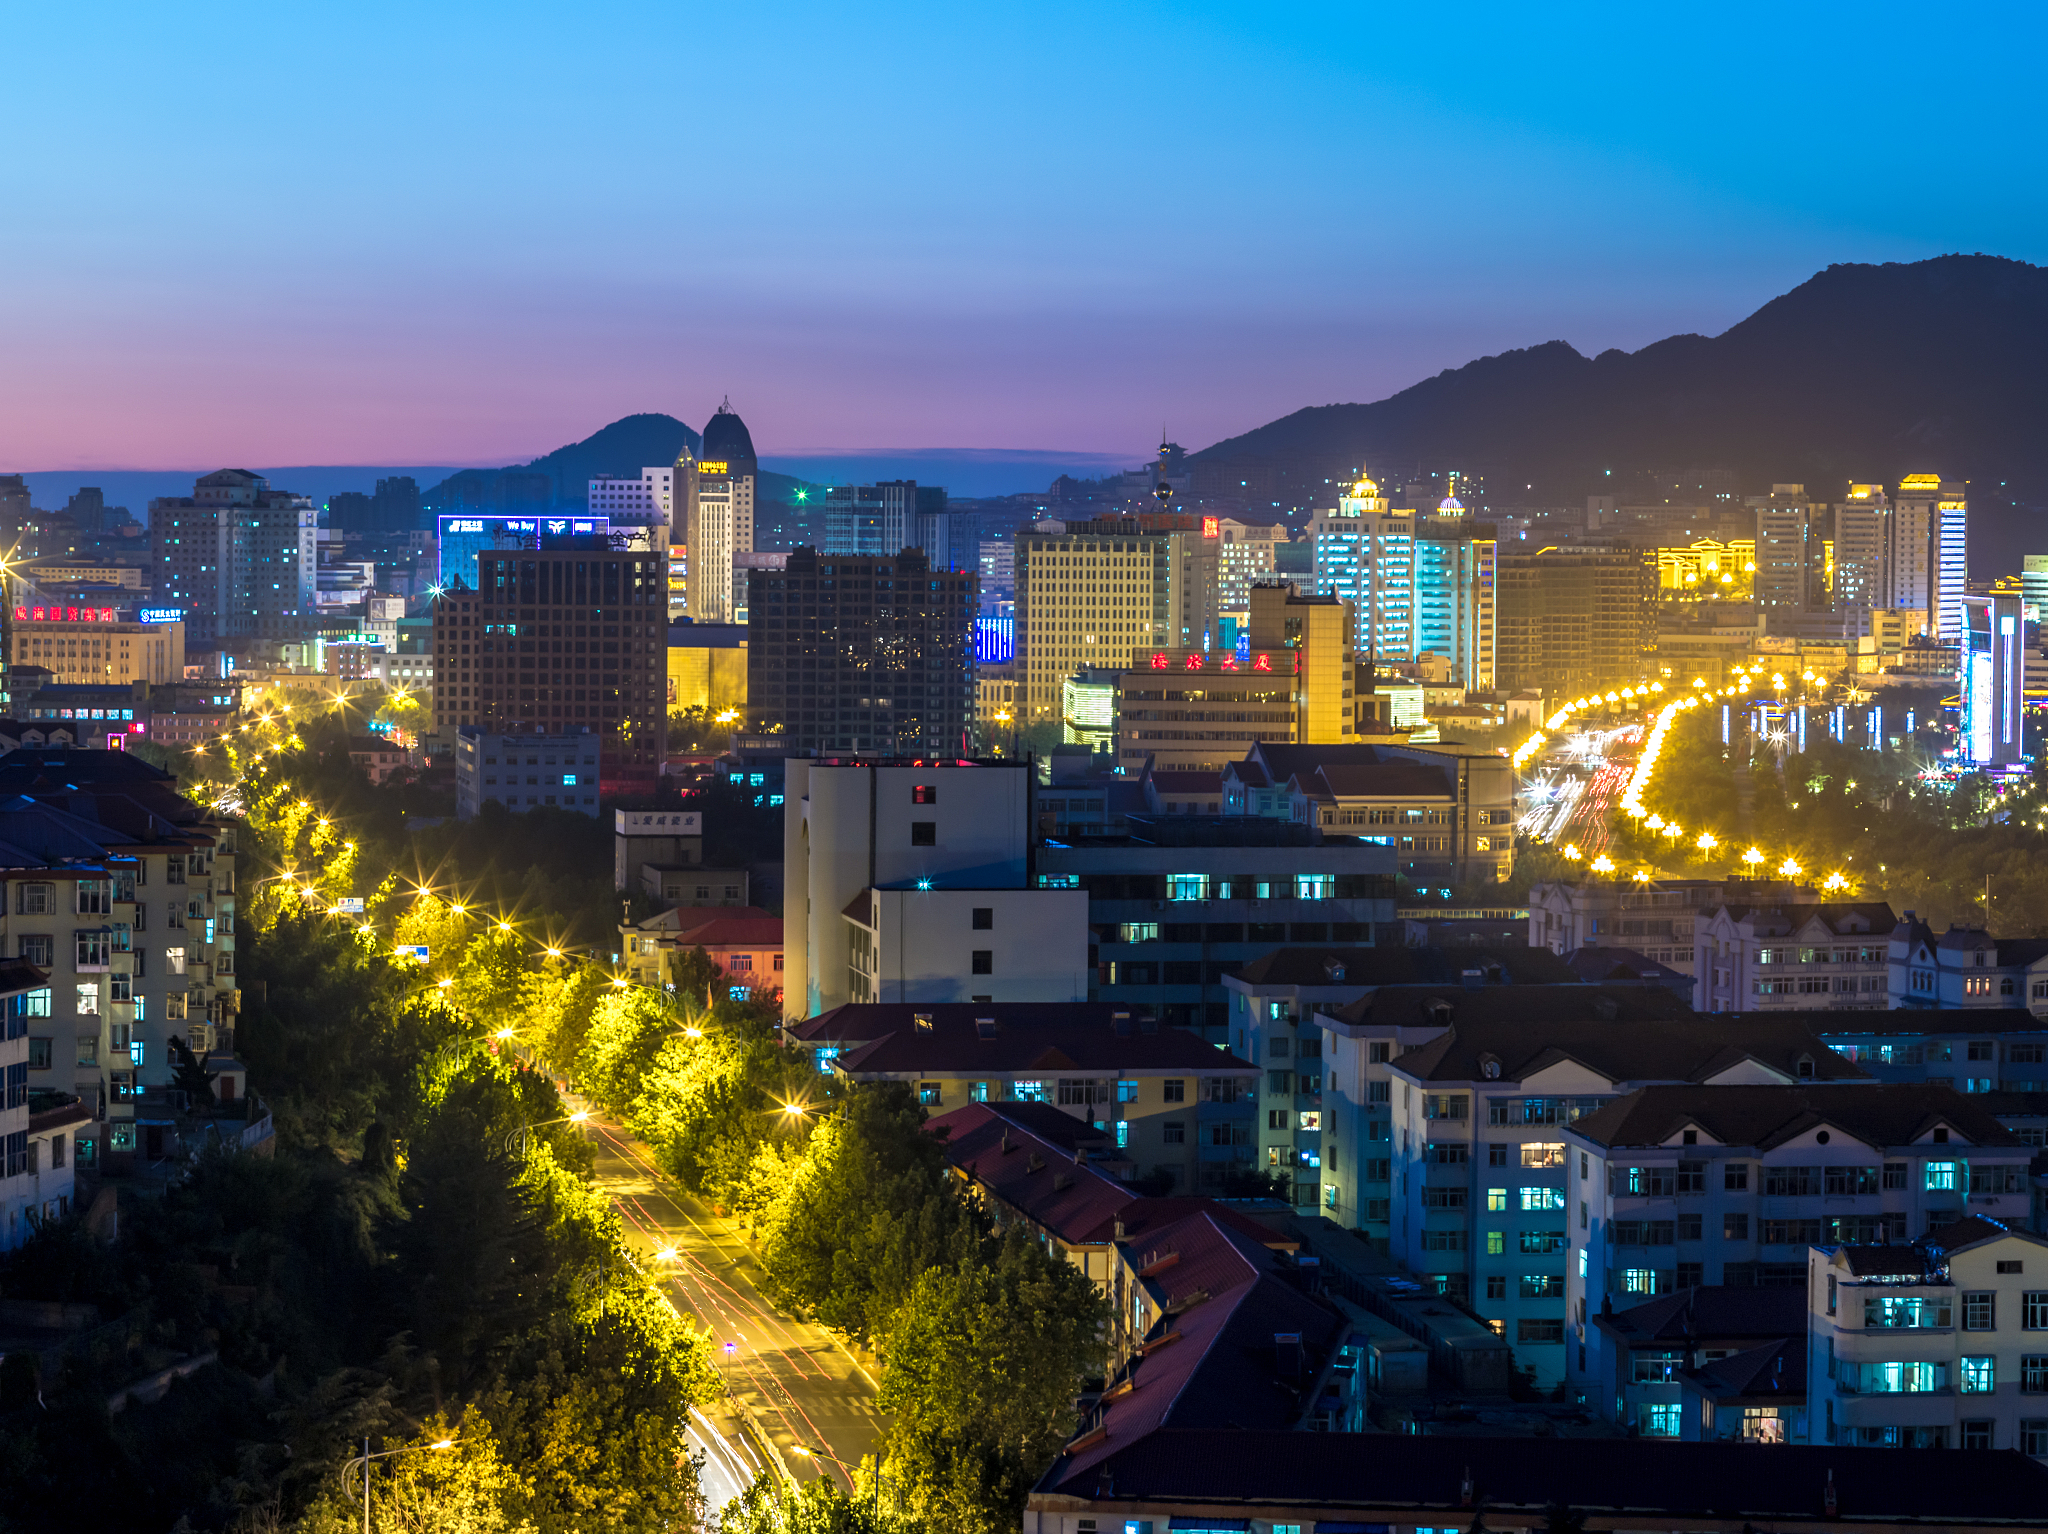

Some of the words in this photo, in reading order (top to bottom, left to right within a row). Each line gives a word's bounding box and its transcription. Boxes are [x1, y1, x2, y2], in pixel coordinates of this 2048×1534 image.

[506, 520, 519, 531] We
[521, 520, 535, 532] Buy
[1102, 513, 1194, 529] 四四医院
